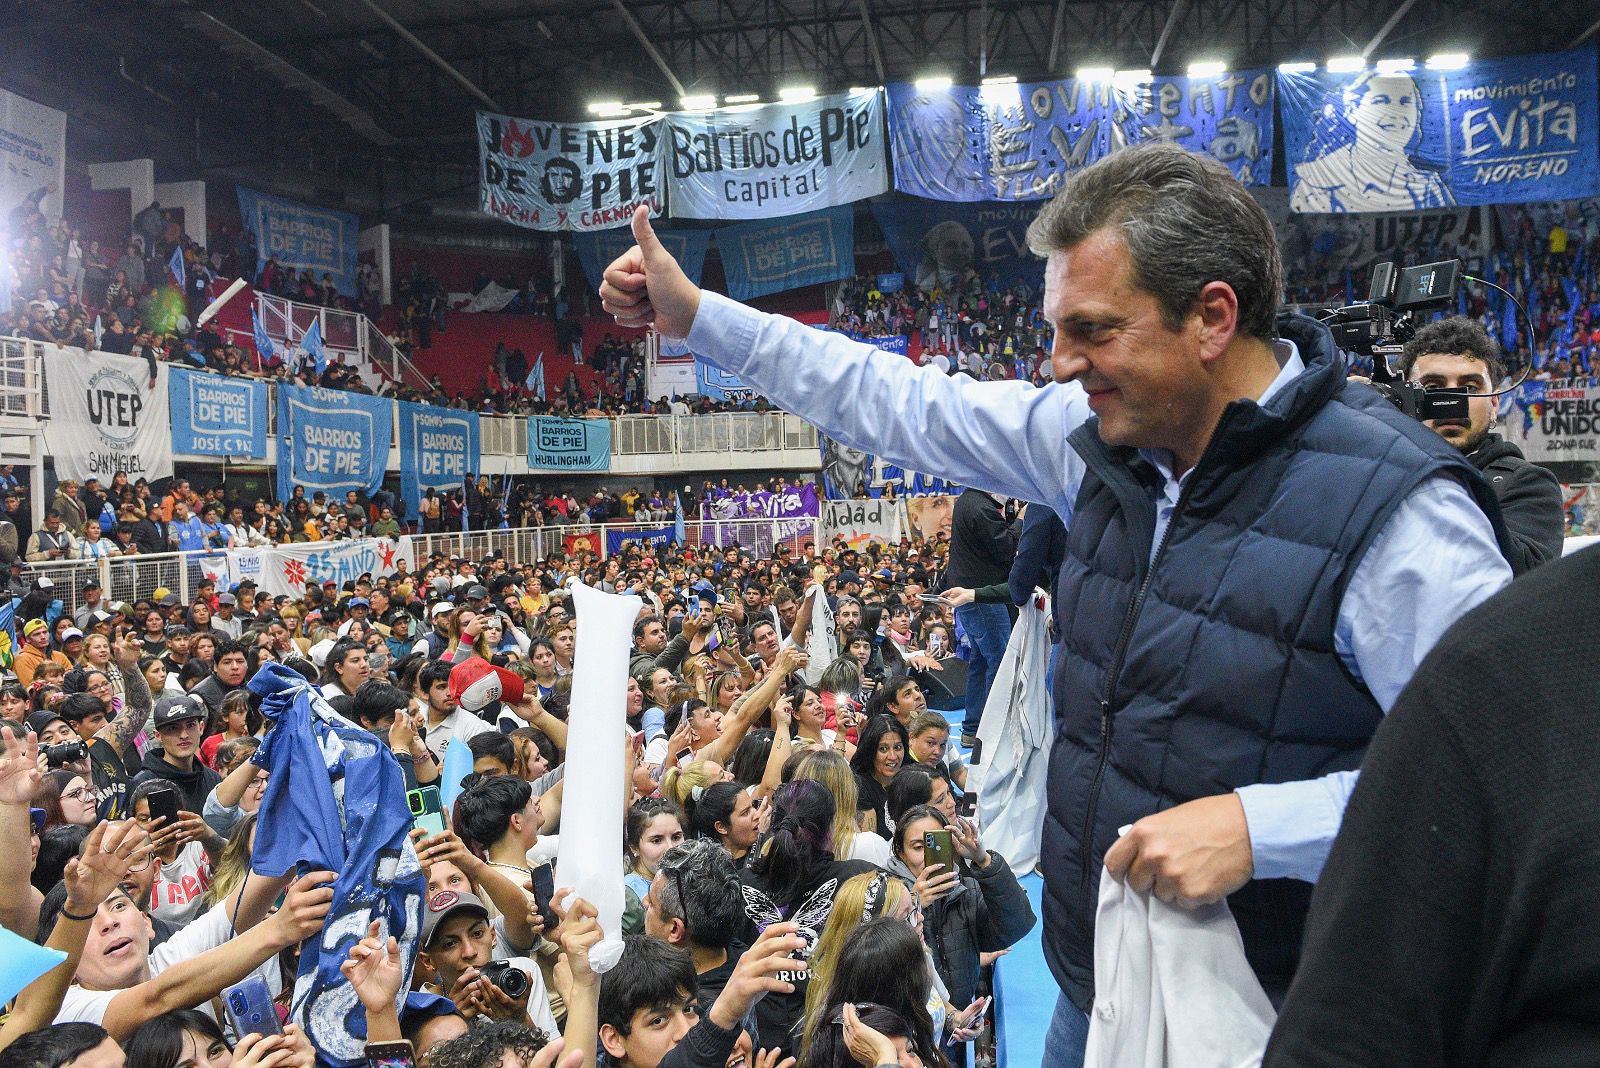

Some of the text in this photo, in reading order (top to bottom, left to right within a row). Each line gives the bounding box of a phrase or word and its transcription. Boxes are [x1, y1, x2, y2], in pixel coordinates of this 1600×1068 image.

[671, 107, 870, 178] Barrios de Pie
[486, 156, 656, 209] DE PIE
[1474, 158, 1568, 185] MORENO
[491, 196, 540, 224] LUCHA
[557, 211, 568, 225] Y
[270, 233, 333, 260] DE PIE
[754, 231, 822, 255] BARRIOS
[757, 244, 824, 271] DE PIE
[87, 389, 142, 427] UTEP
[198, 388, 246, 406] BARRIOS
[199, 402, 247, 425] DE PIE
[192, 436, 221, 451] JOSÉ
[304, 425, 362, 449] BARRIOS
[422, 432, 464, 451] BARRIOS
[542, 427, 582, 436] BARRIOS
[542, 436, 583, 447] DE PIE
[305, 447, 361, 475] DE PIE
[422, 451, 464, 475] DE PIE
[535, 454, 591, 465] HURLINGHAM
[306, 550, 336, 583] 25
